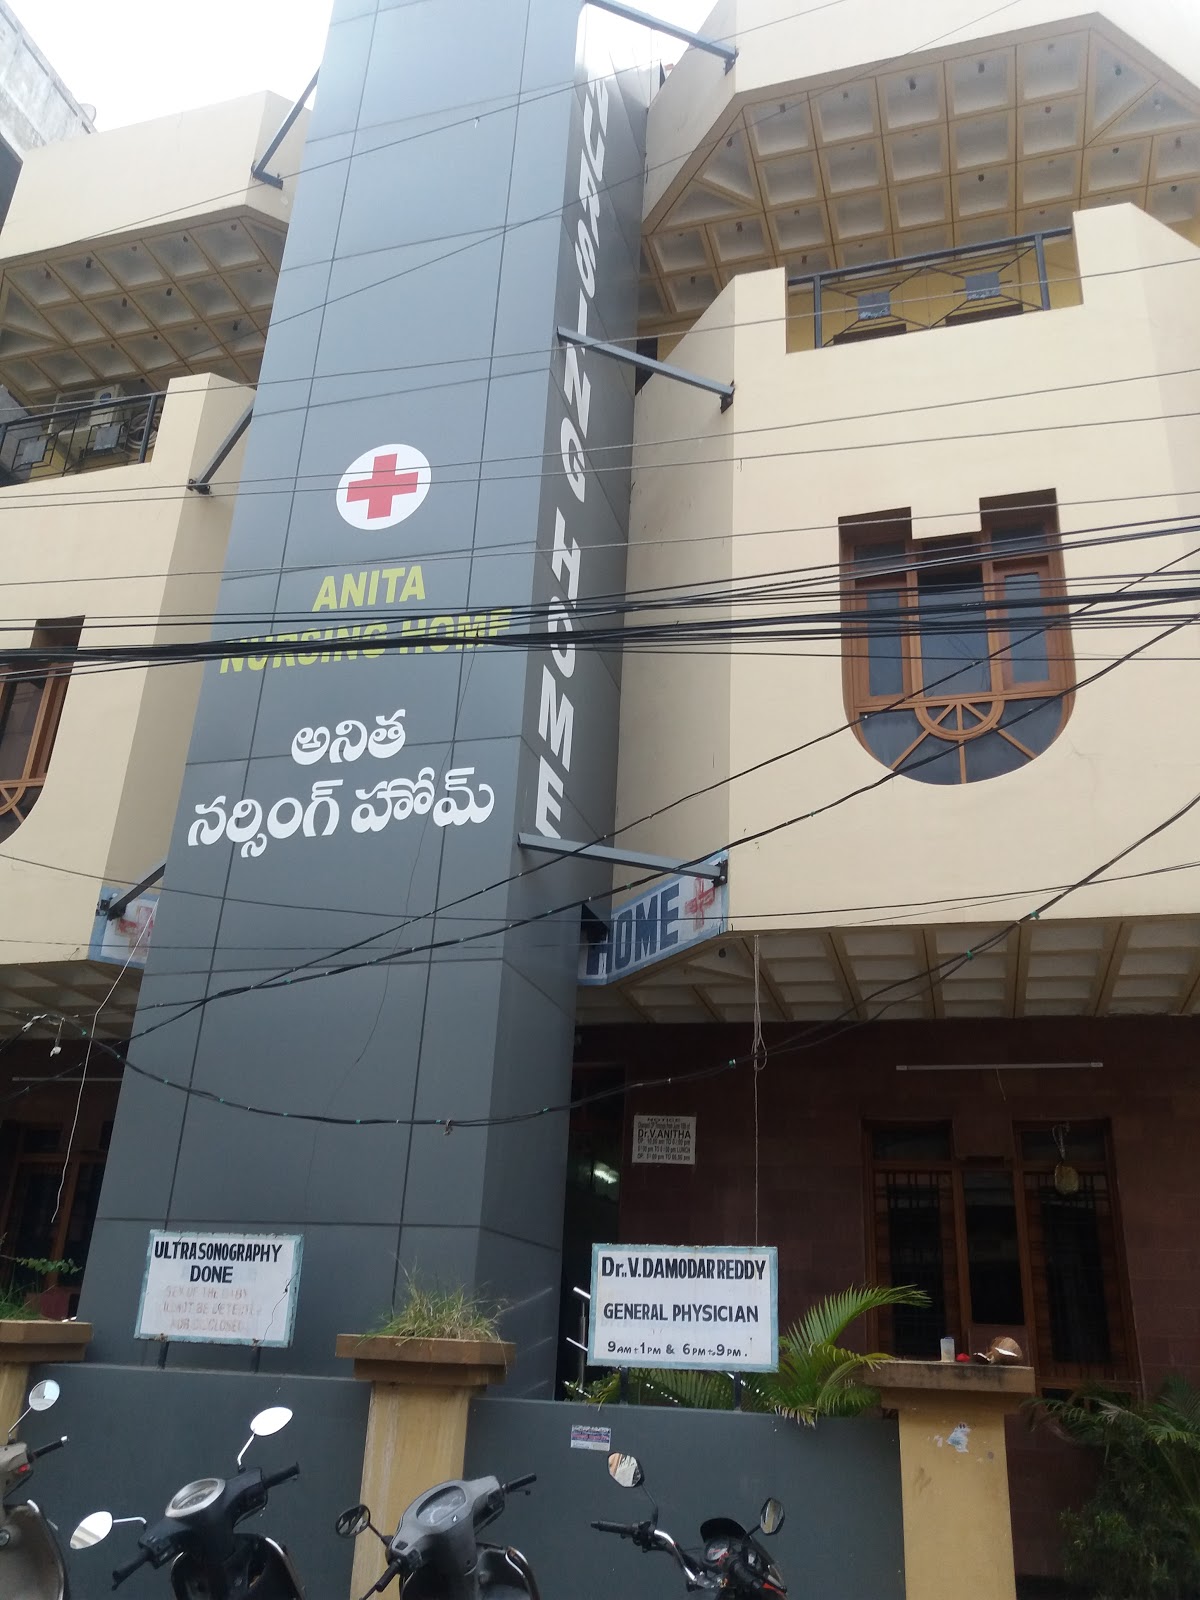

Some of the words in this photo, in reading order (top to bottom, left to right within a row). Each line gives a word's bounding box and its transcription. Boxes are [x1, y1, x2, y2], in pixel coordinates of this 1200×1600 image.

[312, 565, 426, 612] ANITA
[219, 620, 388, 674] NURSING
[399, 608, 512, 654] HOME
[535, 507, 581, 840] HOME
[291, 709, 406, 765] అనిత
[187, 779, 344, 858] నర్సింగ్
[586, 883, 680, 975] HOME
[154, 1241, 282, 1263] ULTRASONOGRAPHY
[190, 1265, 233, 1283] DONE
[717, 1260, 766, 1280] REDDY
[604, 1303, 668, 1321] GENERAL
[673, 1304, 759, 1323] PHYSICIAN
[666, 1344, 675, 1354] &
